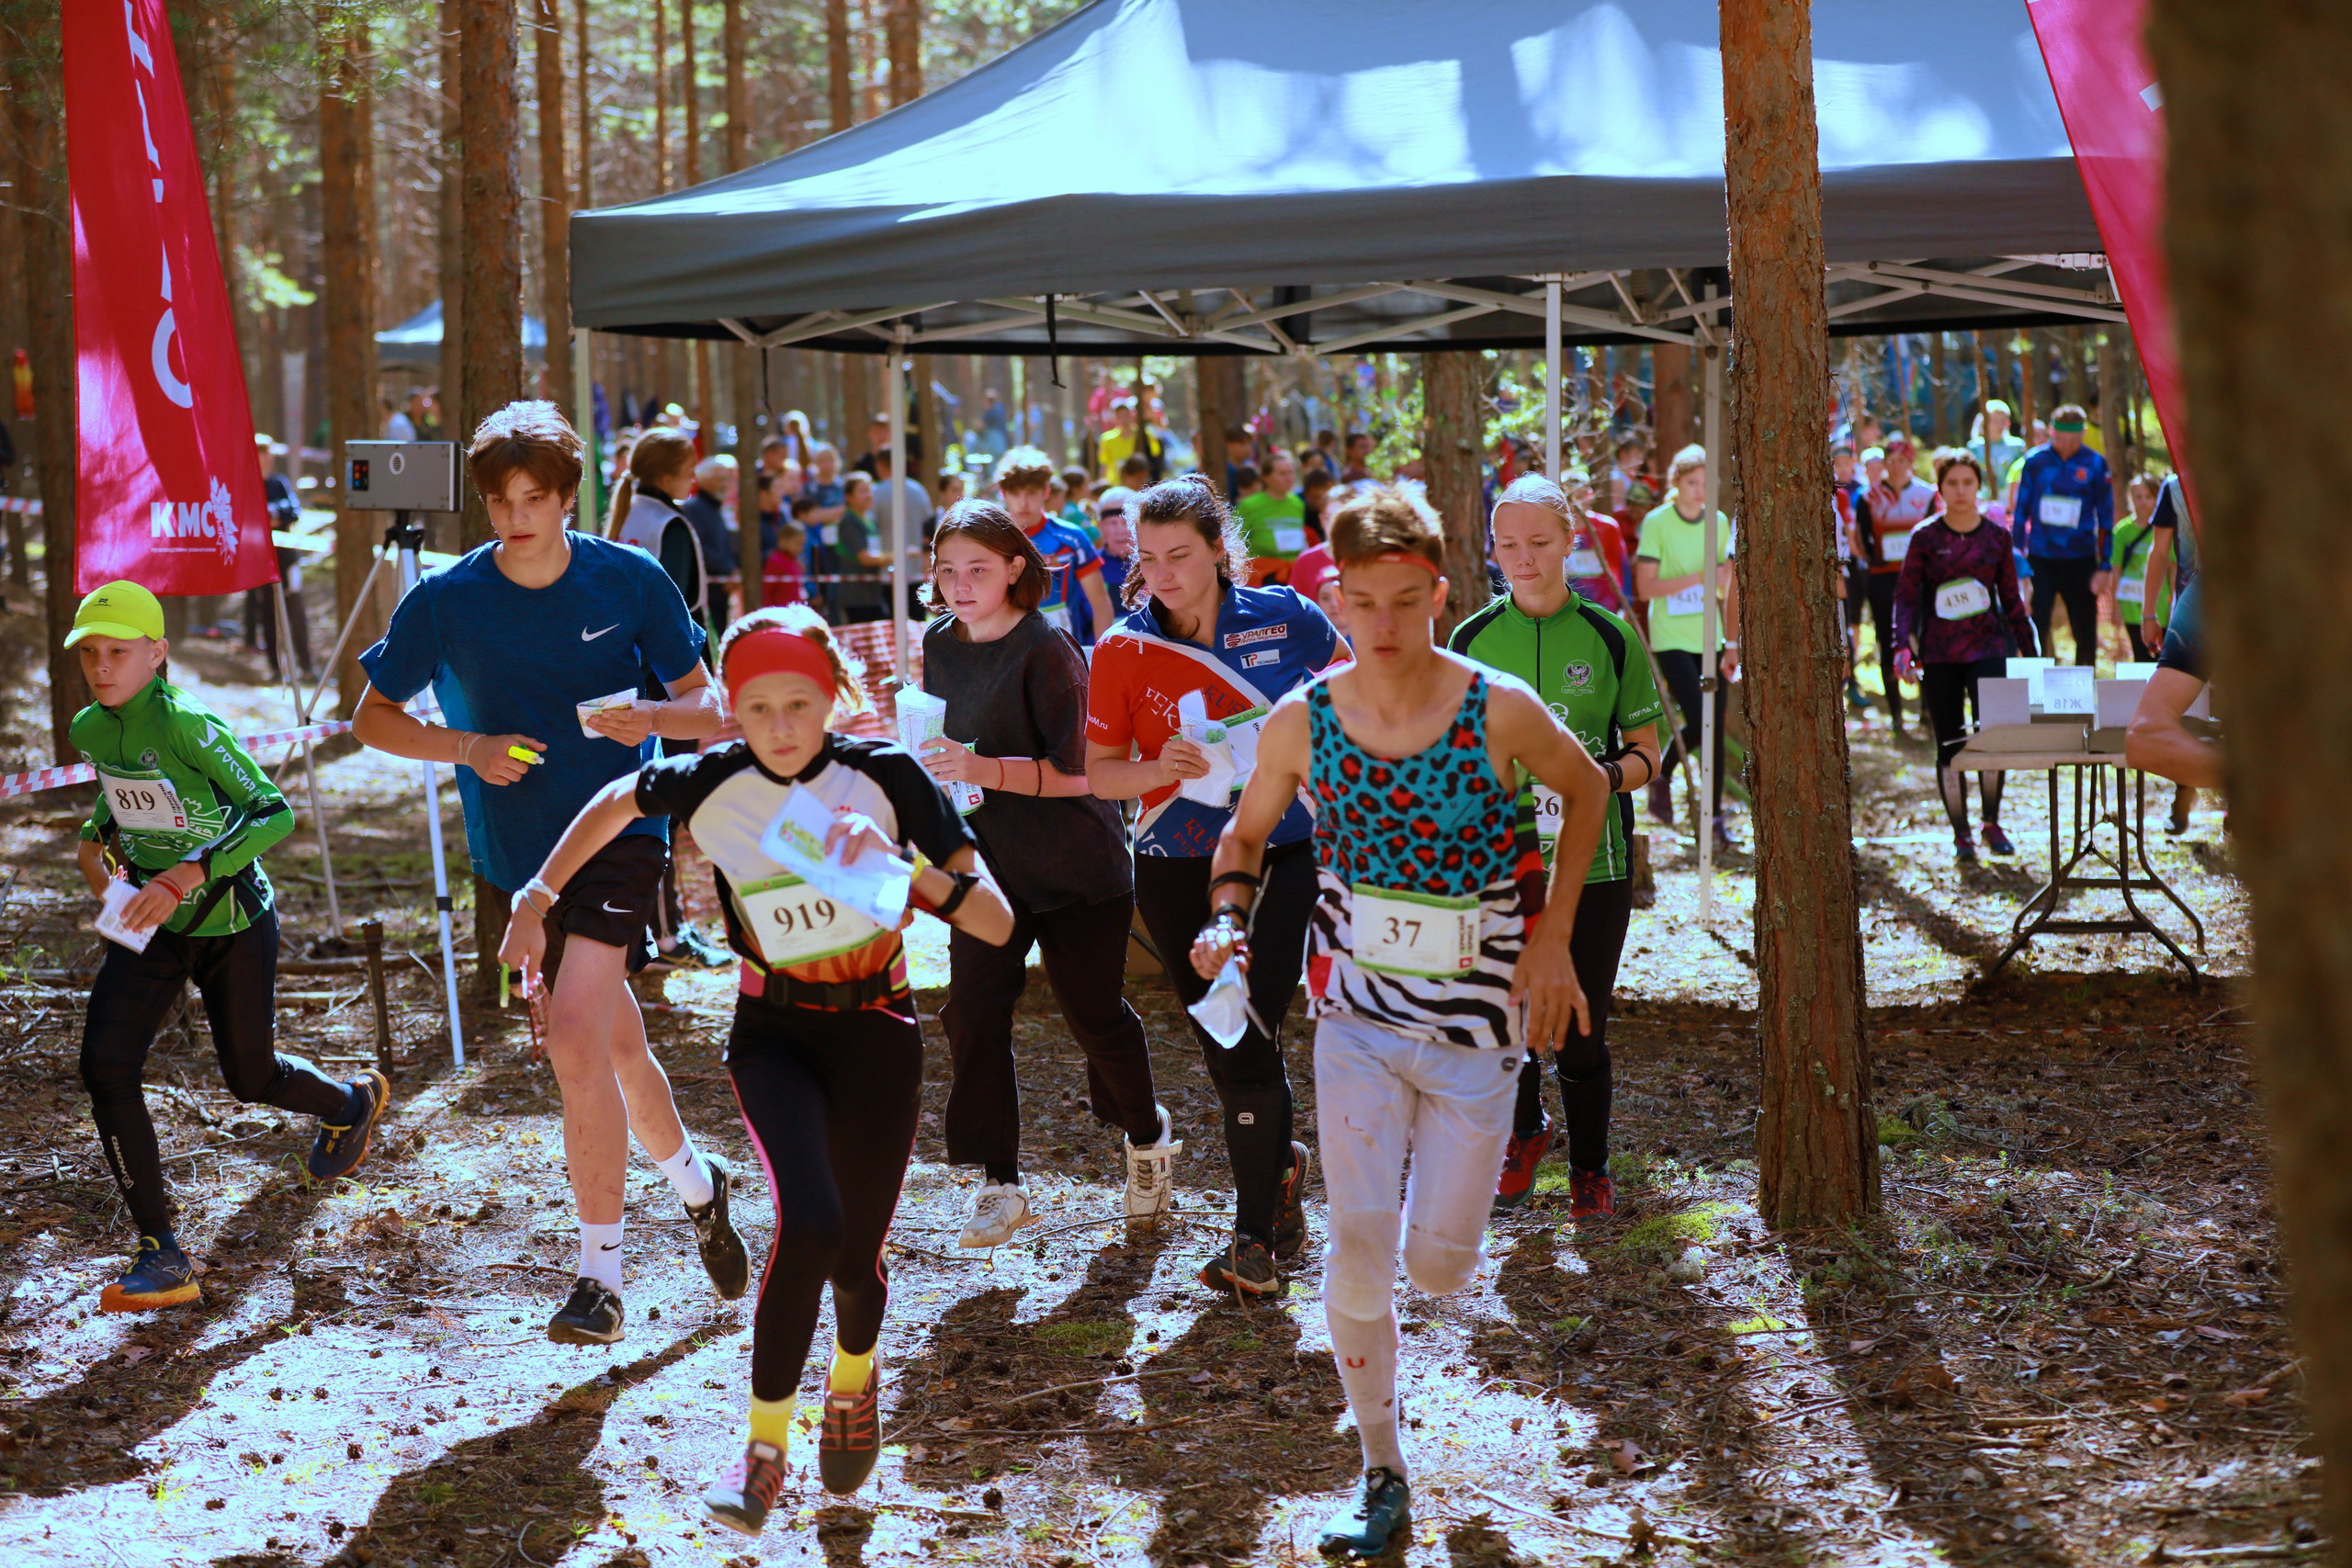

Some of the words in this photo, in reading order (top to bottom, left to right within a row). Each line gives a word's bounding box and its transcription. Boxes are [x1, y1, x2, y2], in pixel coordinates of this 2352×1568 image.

[1241, 625, 1285, 639] УРАЛГЕО
[214, 745, 256, 793] РОССИЯ
[115, 788, 155, 811] 819
[774, 898, 836, 936] 919
[1383, 916, 1422, 948] 37
